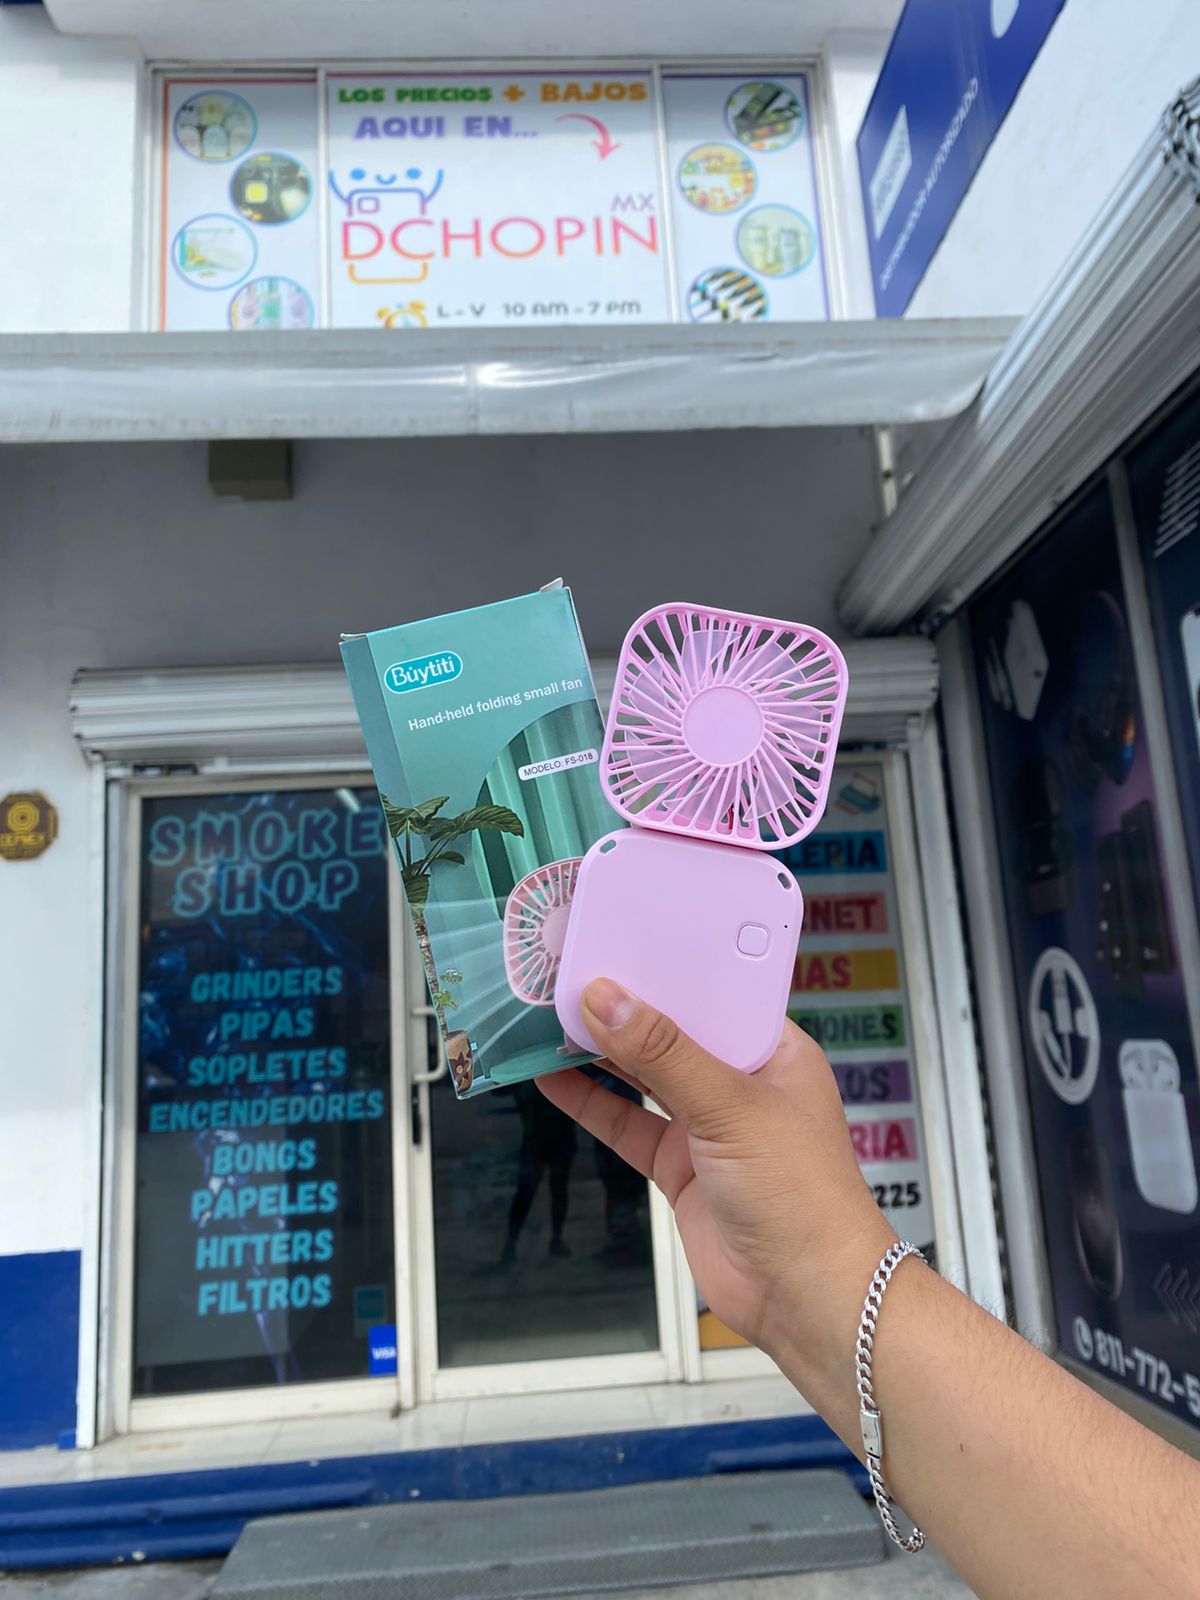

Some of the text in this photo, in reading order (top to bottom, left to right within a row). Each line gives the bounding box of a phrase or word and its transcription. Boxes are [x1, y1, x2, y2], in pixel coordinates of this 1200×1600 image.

[338, 88, 385, 103] LOS
[395, 87, 493, 102] PRECIOS
[540, 82, 648, 102] BAJOS
[354, 116, 446, 139] AQUI
[611, 193, 656, 212] MX
[341, 215, 659, 261] DCHOPIN
[502, 302, 526, 317] 10
[407, 677, 583, 732] Hand-held folding small fan
[522, 752, 594, 778] MODELO: FS-018
[150, 808, 385, 866] SMOKE
[173, 859, 359, 918] SHOP
[801, 898, 877, 931] NET
[191, 966, 343, 1003] GRINDERS
[220, 1008, 314, 1042] PIPAS
[189, 1049, 346, 1085] SOPLETES
[150, 1091, 384, 1132] ENCENDEDORES
[212, 1138, 317, 1176] BONGS
[190, 1182, 339, 1221] PAPELES
[195, 1230, 334, 1270] HITTERS
[198, 1275, 331, 1315] FILTROS
